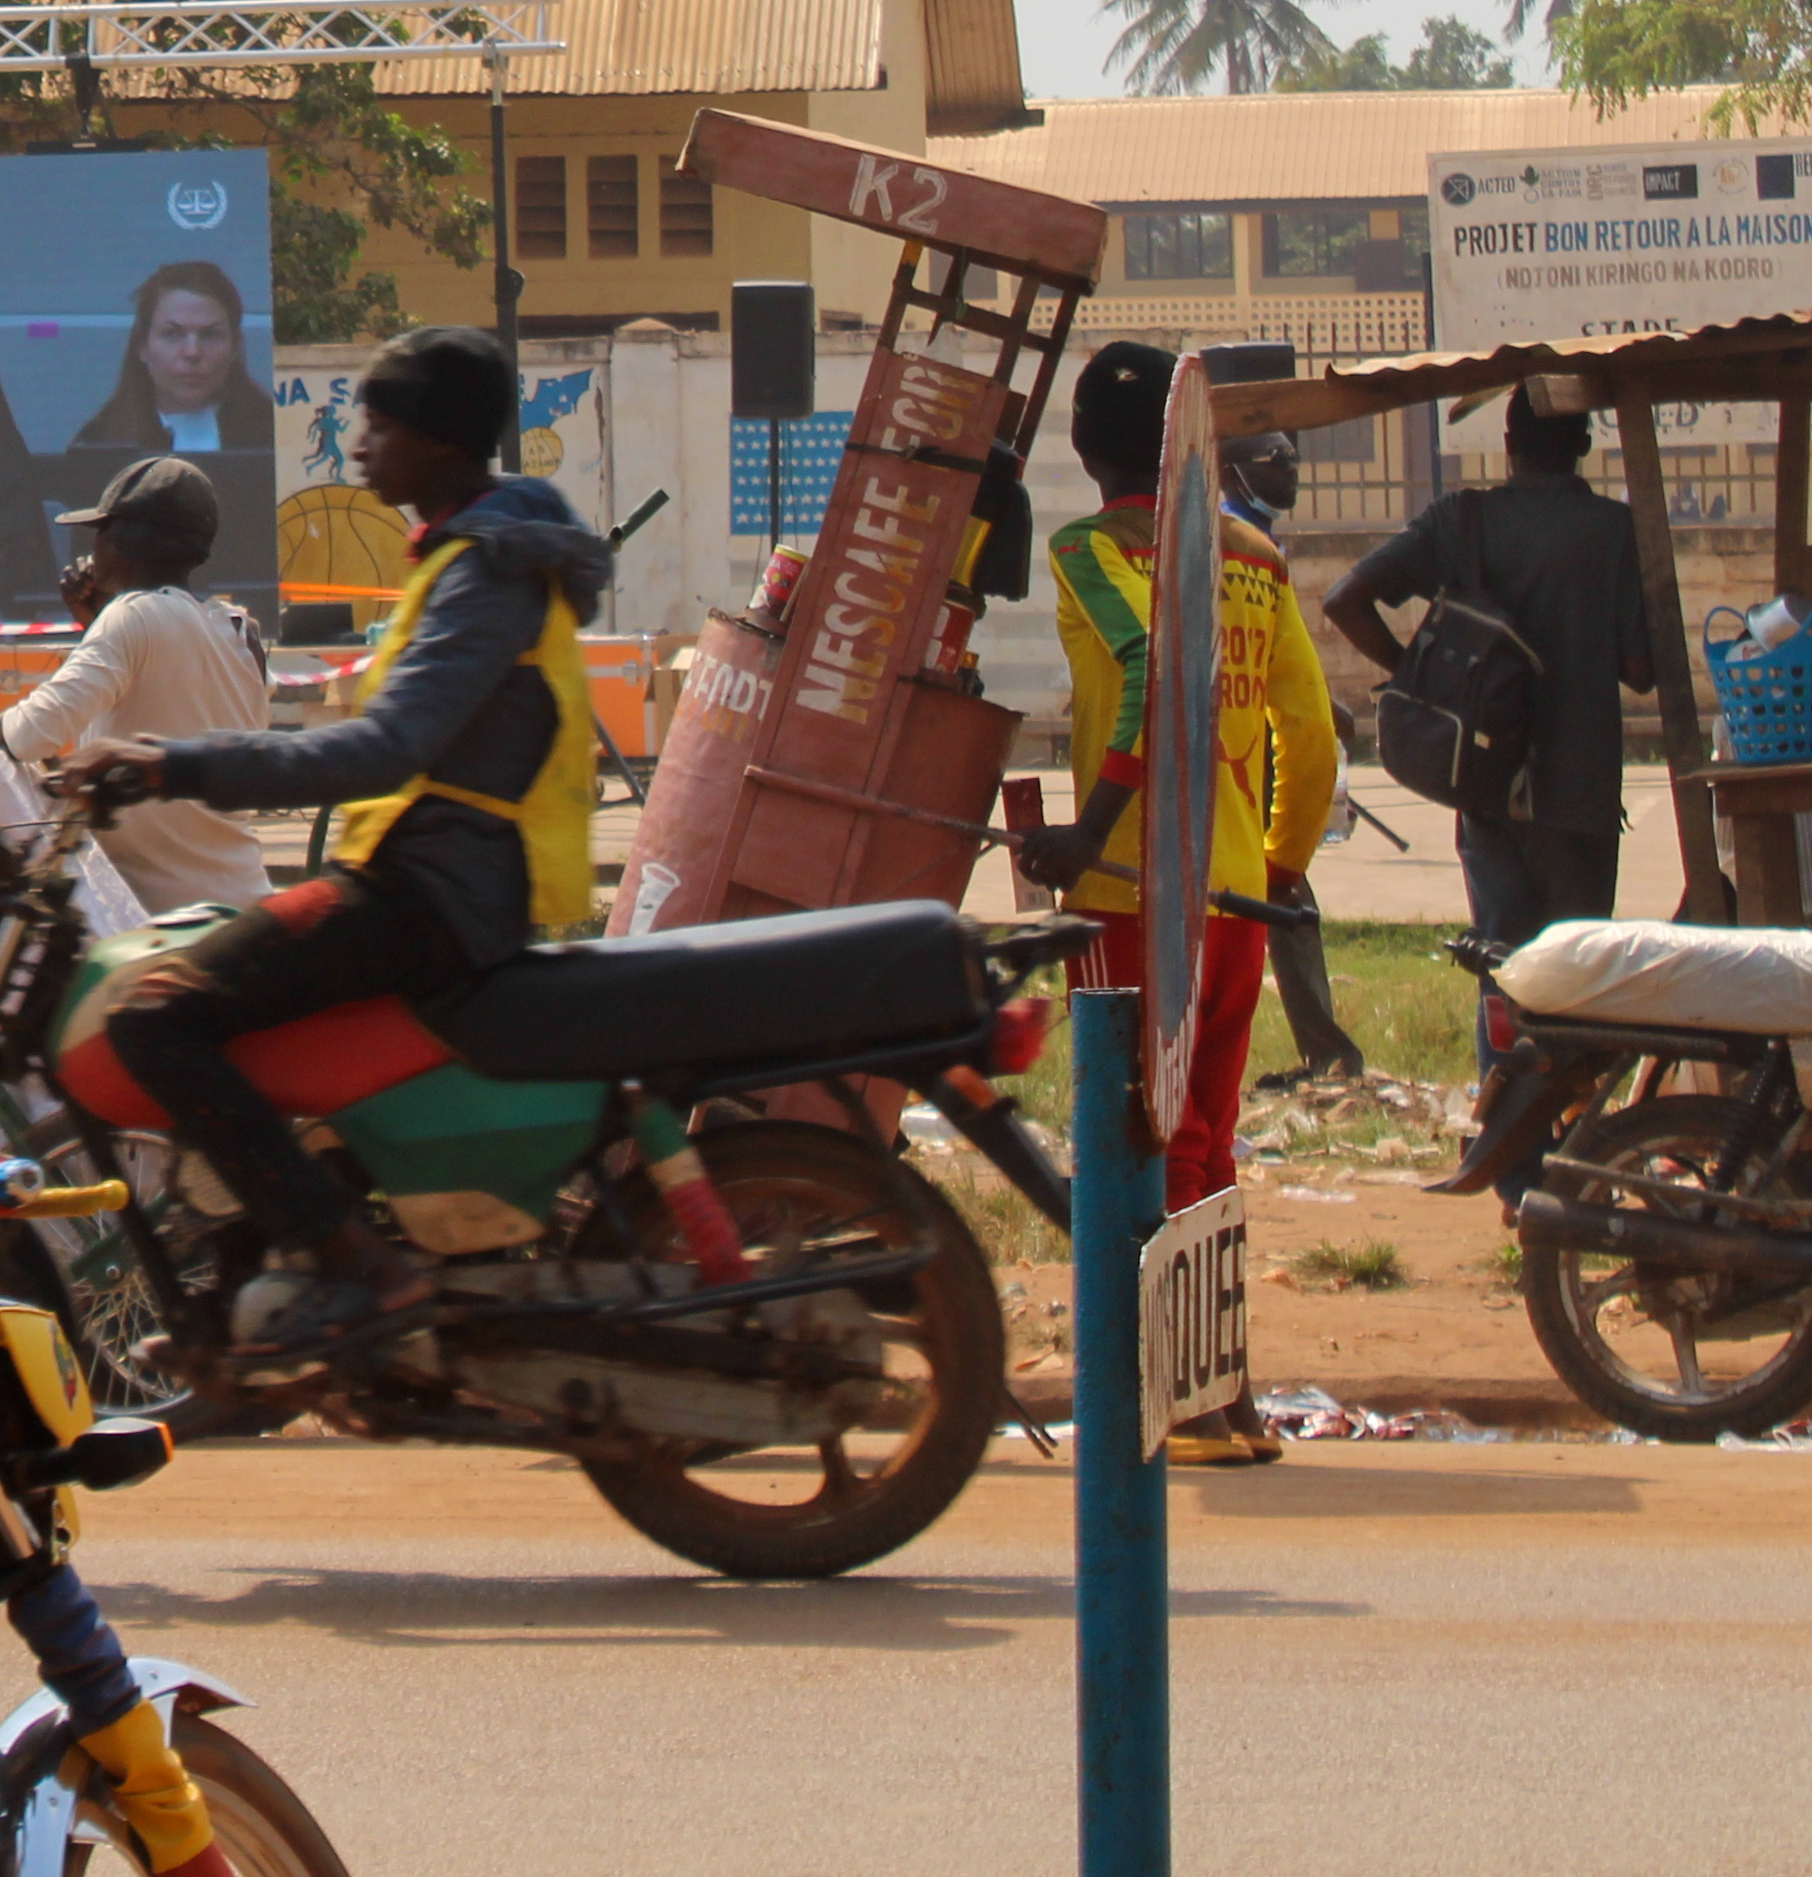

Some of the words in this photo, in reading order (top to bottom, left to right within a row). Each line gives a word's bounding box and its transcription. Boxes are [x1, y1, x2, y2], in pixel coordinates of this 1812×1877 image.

[848, 152, 948, 236] K2
[1478, 177, 1516, 194] ACTED
[1454, 222, 1538, 257] PROJET
[1545, 221, 1589, 252] BON
[1595, 218, 1681, 252] RETOUR
[1687, 216, 1701, 248] A
[1706, 215, 1732, 247] LA
[1737, 213, 1812, 246] MAISON
[1586, 260, 1666, 288] KIRINGO
[1672, 259, 1704, 283] NA
[796, 476, 941, 725] NESCAFE
[879, 353, 978, 468] FOR
